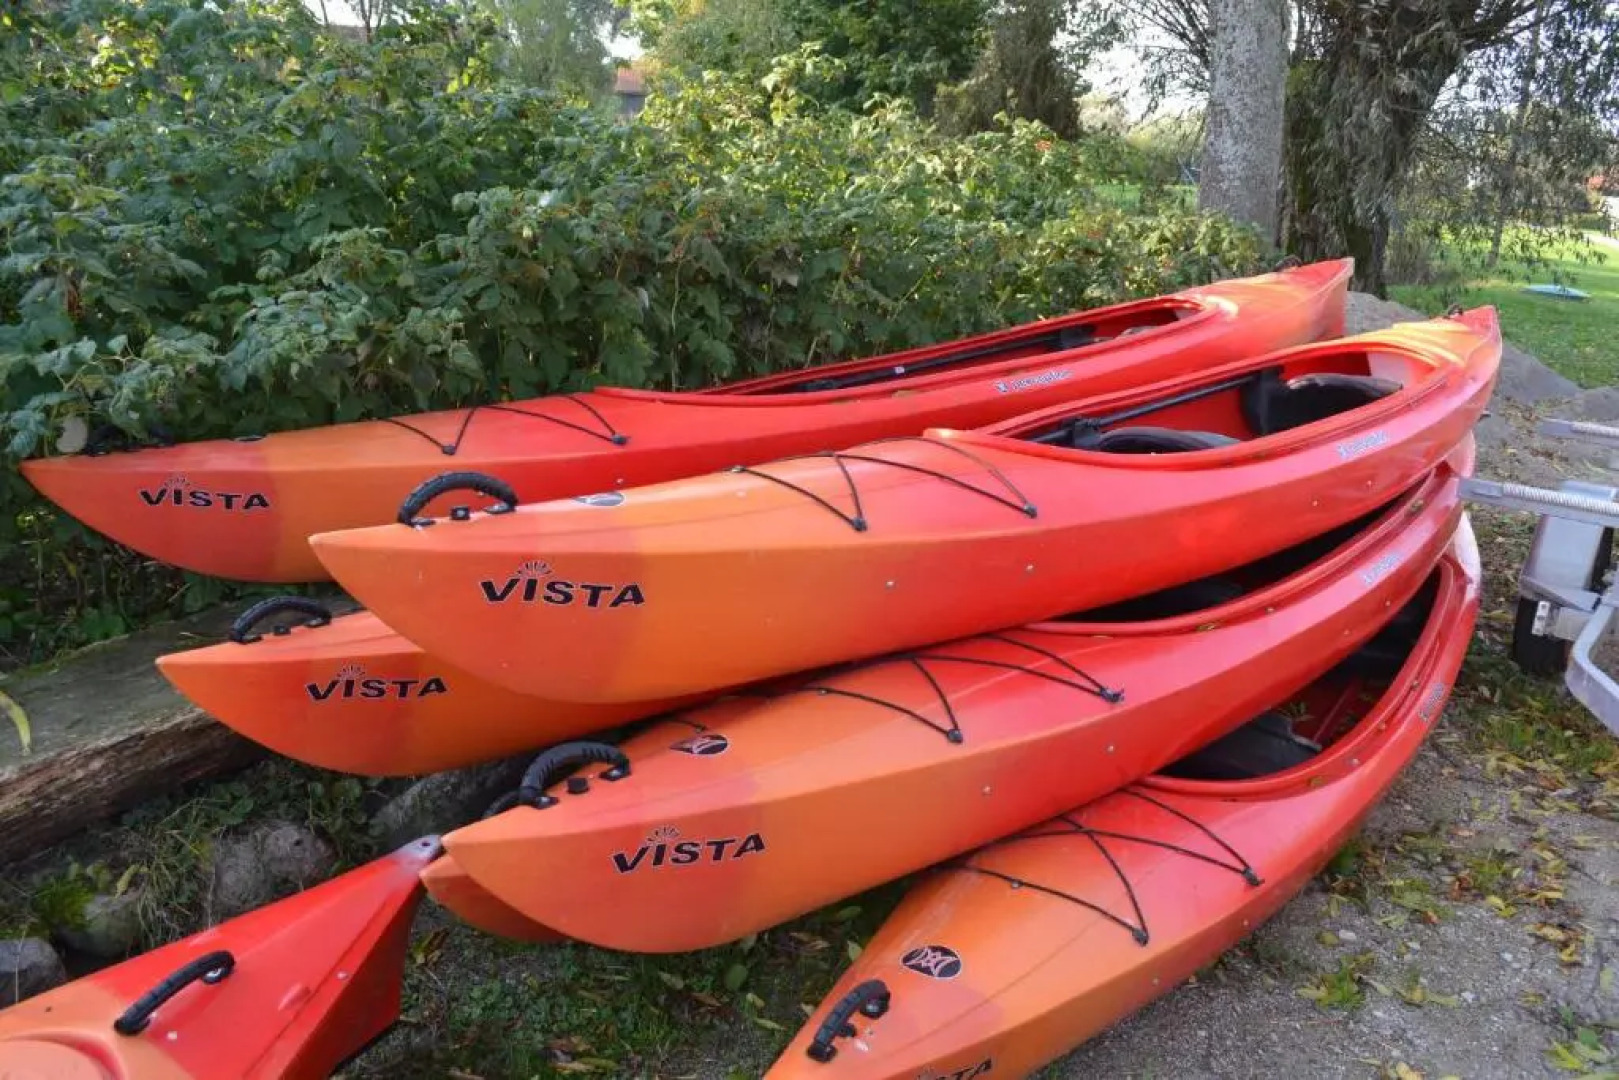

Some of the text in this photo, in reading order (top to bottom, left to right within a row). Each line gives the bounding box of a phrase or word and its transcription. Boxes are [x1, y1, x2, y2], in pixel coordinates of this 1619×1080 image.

[140, 488, 269, 510] VISTA
[481, 577, 645, 608] VISTA
[306, 676, 447, 700] VISTA
[612, 832, 765, 874] VISTA
